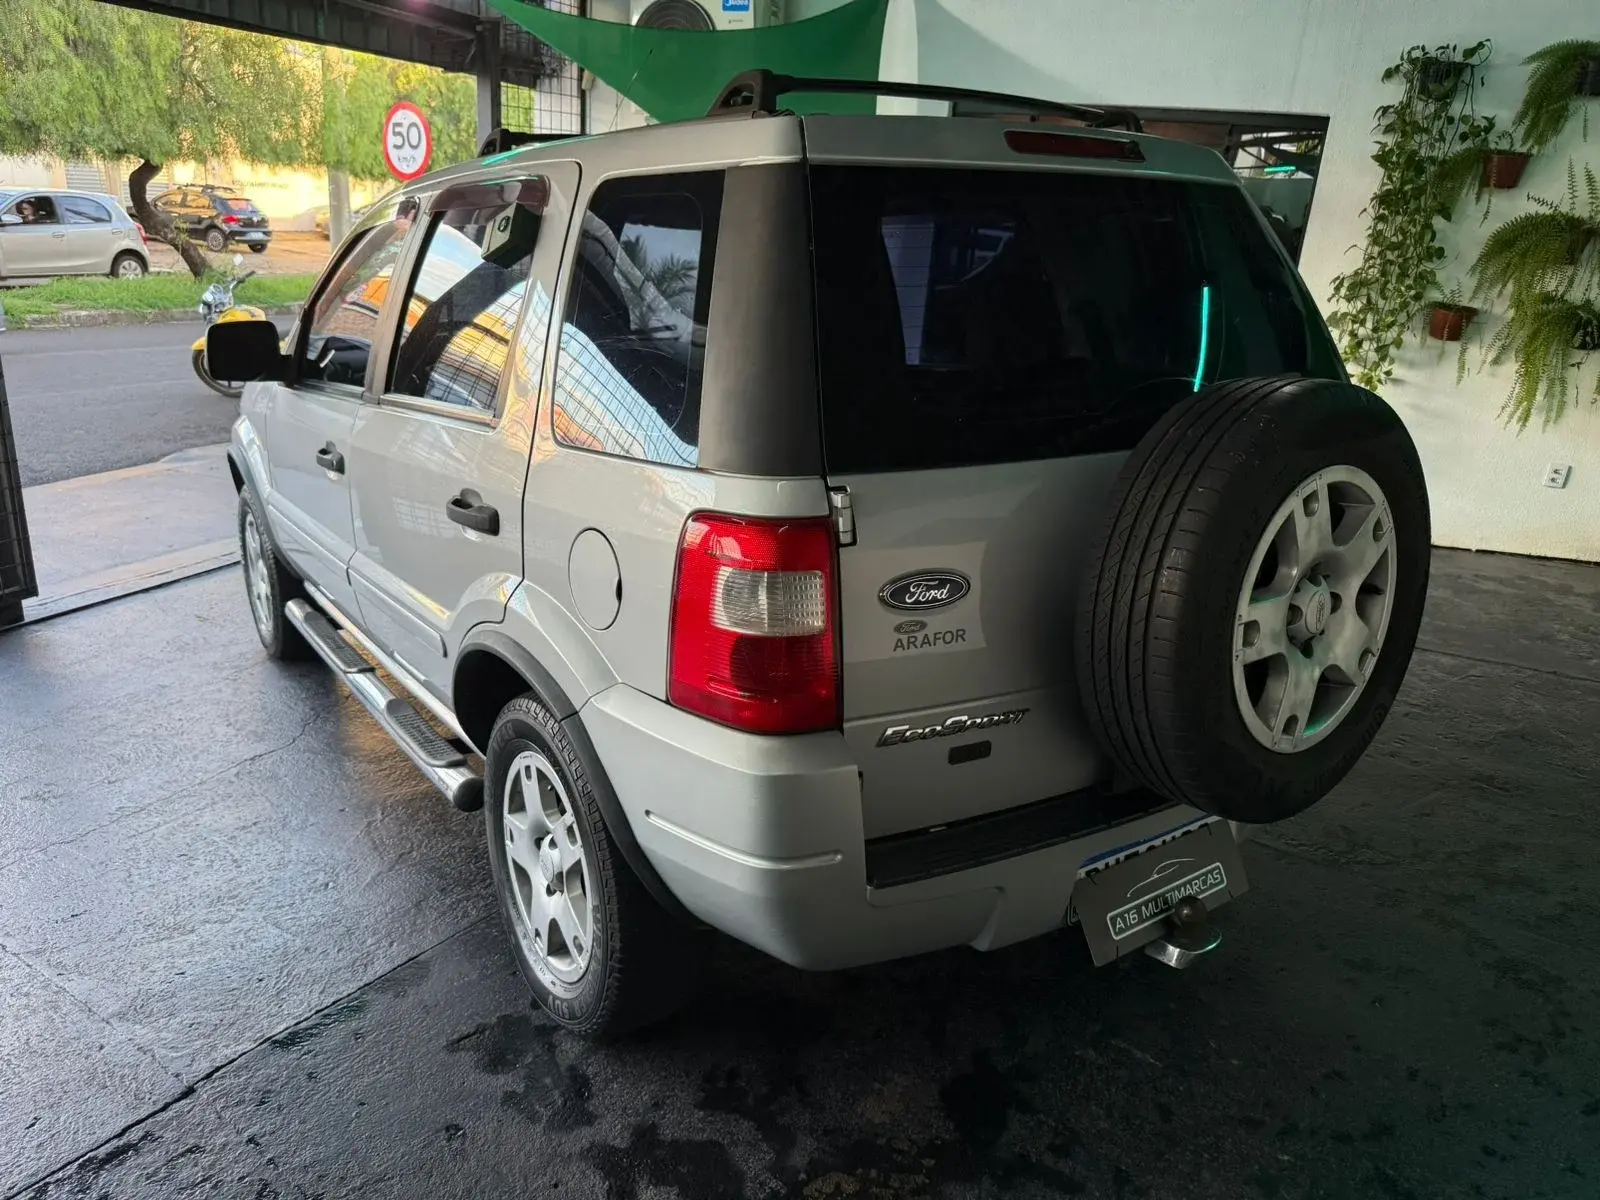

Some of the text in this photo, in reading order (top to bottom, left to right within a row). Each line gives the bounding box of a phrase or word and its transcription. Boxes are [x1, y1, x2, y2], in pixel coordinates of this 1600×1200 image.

[392, 122, 421, 150] 50
[905, 581, 950, 603] Ford
[893, 628, 966, 652] ARAFOR
[1115, 911, 1139, 932] A16
[1141, 869, 1222, 919] MULTIMARCAS
